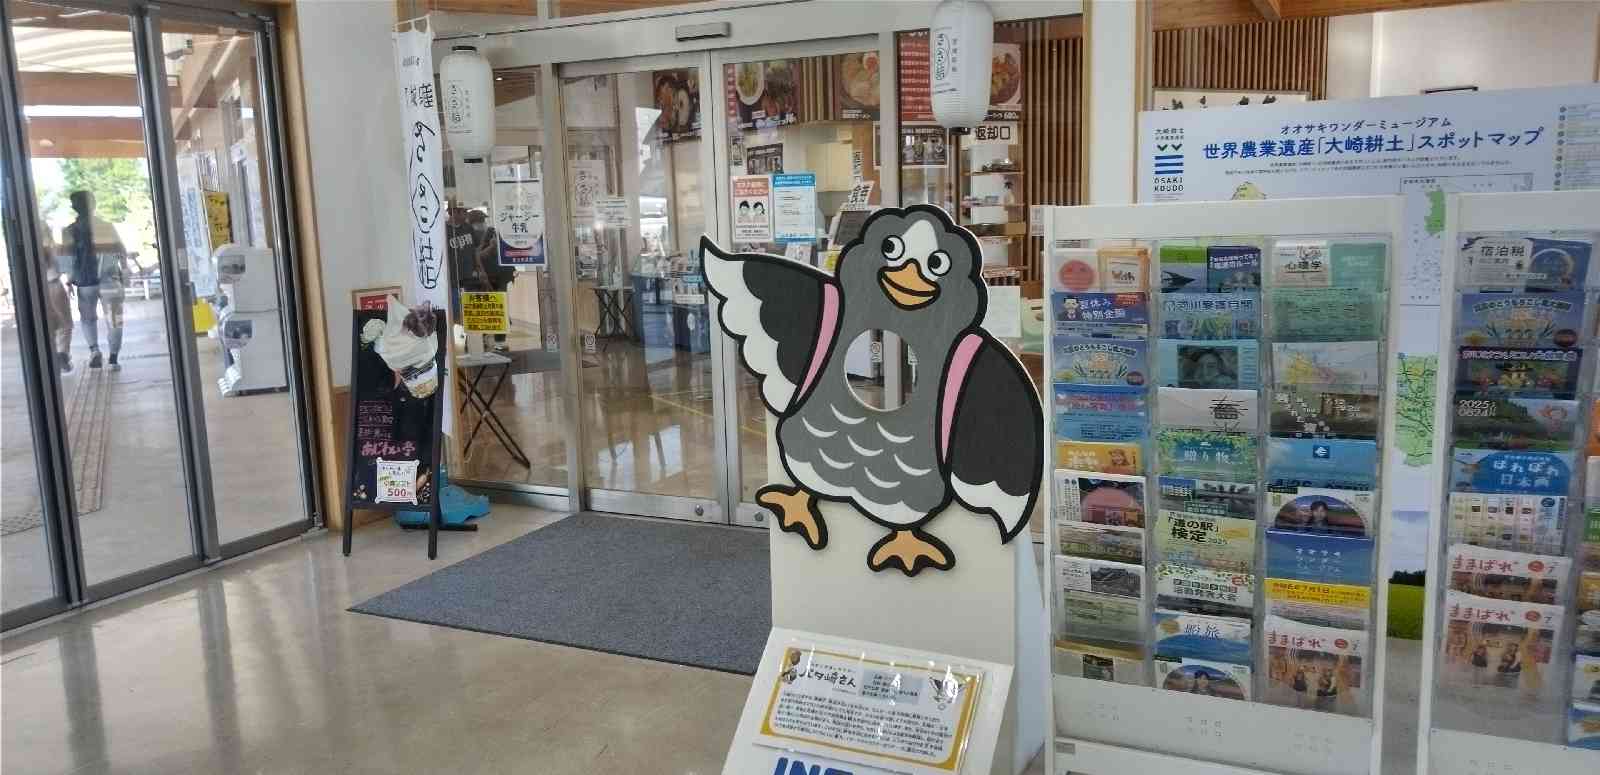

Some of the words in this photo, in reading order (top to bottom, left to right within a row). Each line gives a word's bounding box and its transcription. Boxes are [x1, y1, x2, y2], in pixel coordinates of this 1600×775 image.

[976, 126, 1011, 140] 返却口
[1281, 117, 1451, 135] オオサキワンダーミュージアム
[1203, 126, 1544, 160] 世界農業遺産「大崎耕土」スポットマップ
[1154, 177, 1184, 185] OSAKI
[511, 222, 529, 234] 牛乳
[1285, 259, 1323, 271] 心理学
[1171, 526, 1207, 543] 検定
